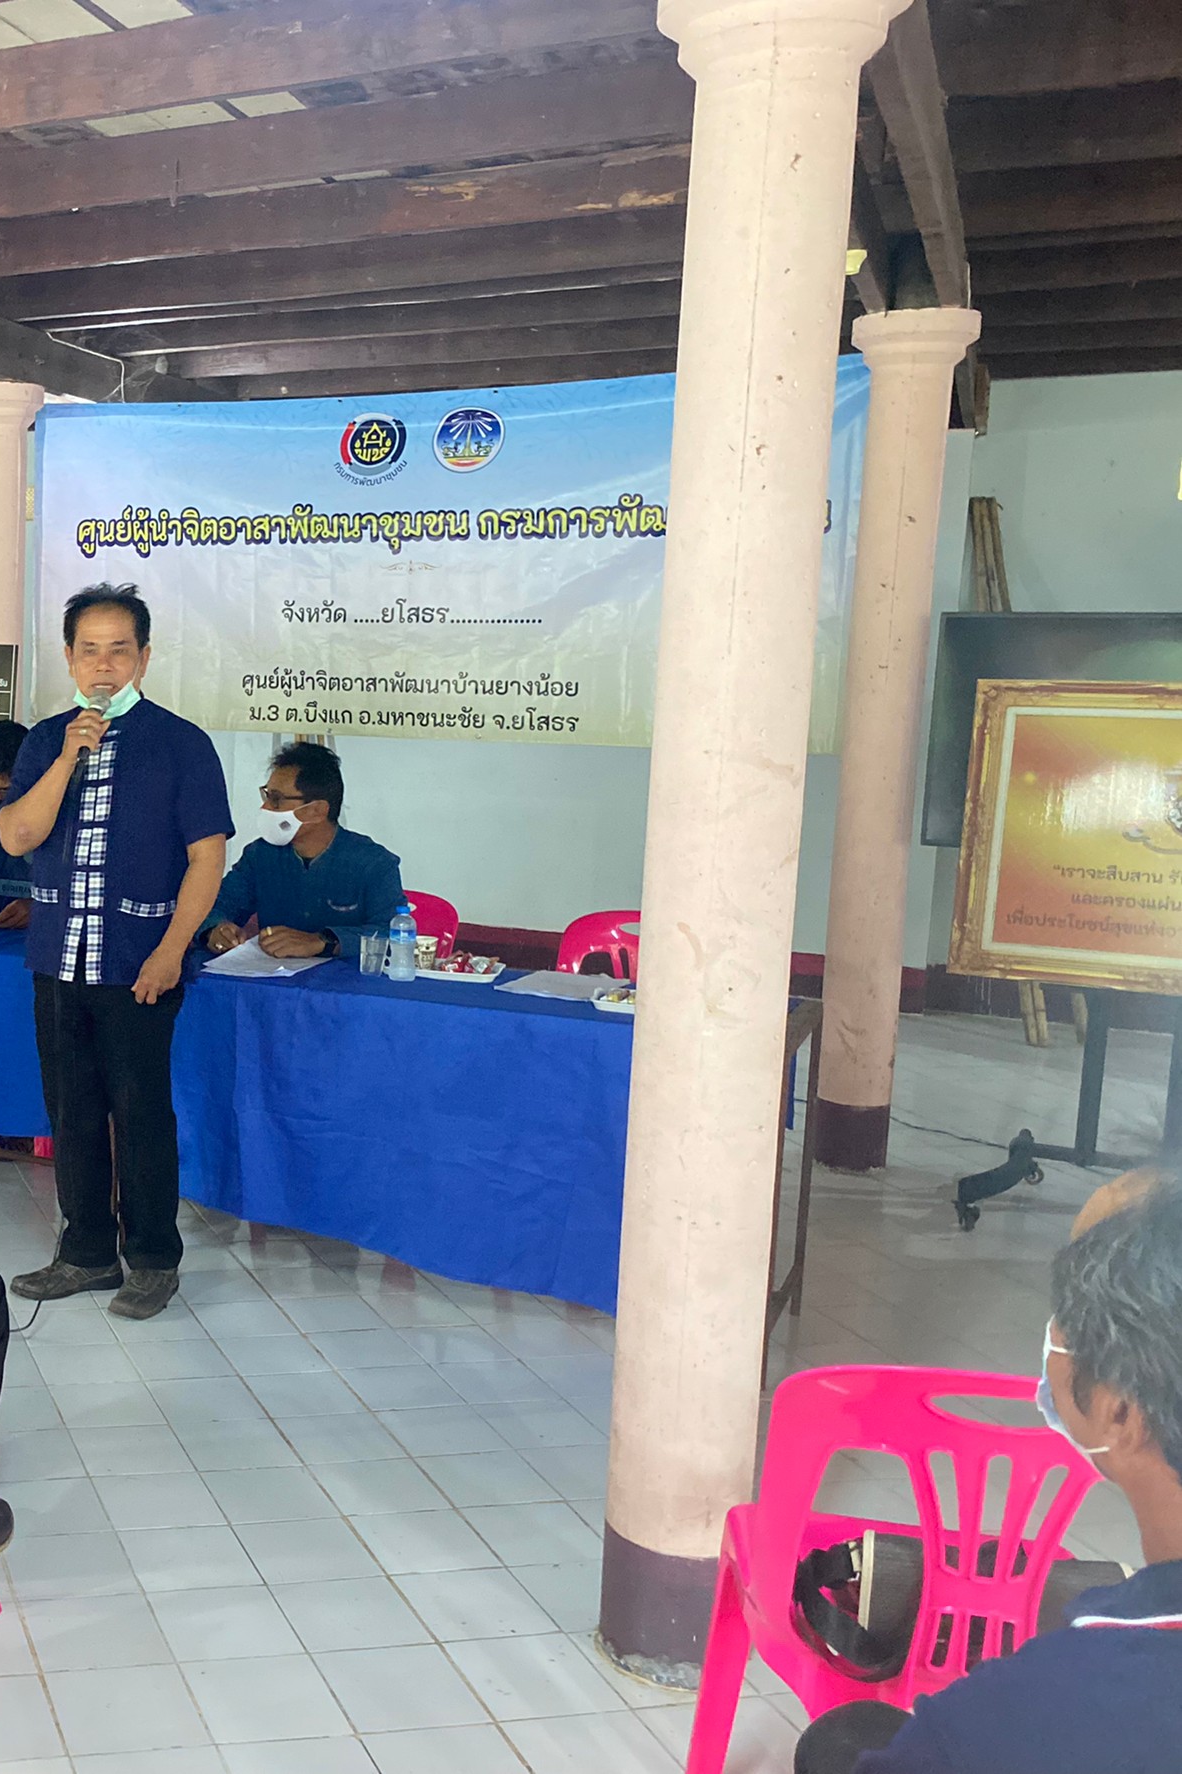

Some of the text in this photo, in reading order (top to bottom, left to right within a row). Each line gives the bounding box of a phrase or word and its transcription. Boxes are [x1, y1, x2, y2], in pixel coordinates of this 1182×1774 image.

[77, 492, 668, 558] ศูนย์ผู้นำจิตอาสาพัฒนาชุมชน กรมการพัฒ
[281, 600, 347, 624] จังหวัด
[242, 667, 579, 699] ศูนย์ผู้นำจิตอาสาพัฒนาบ้านยางน้อย
[249, 701, 580, 733] ม.3 ต.บึงแก อ.มหาชนะชัย จ.ยโสธร
